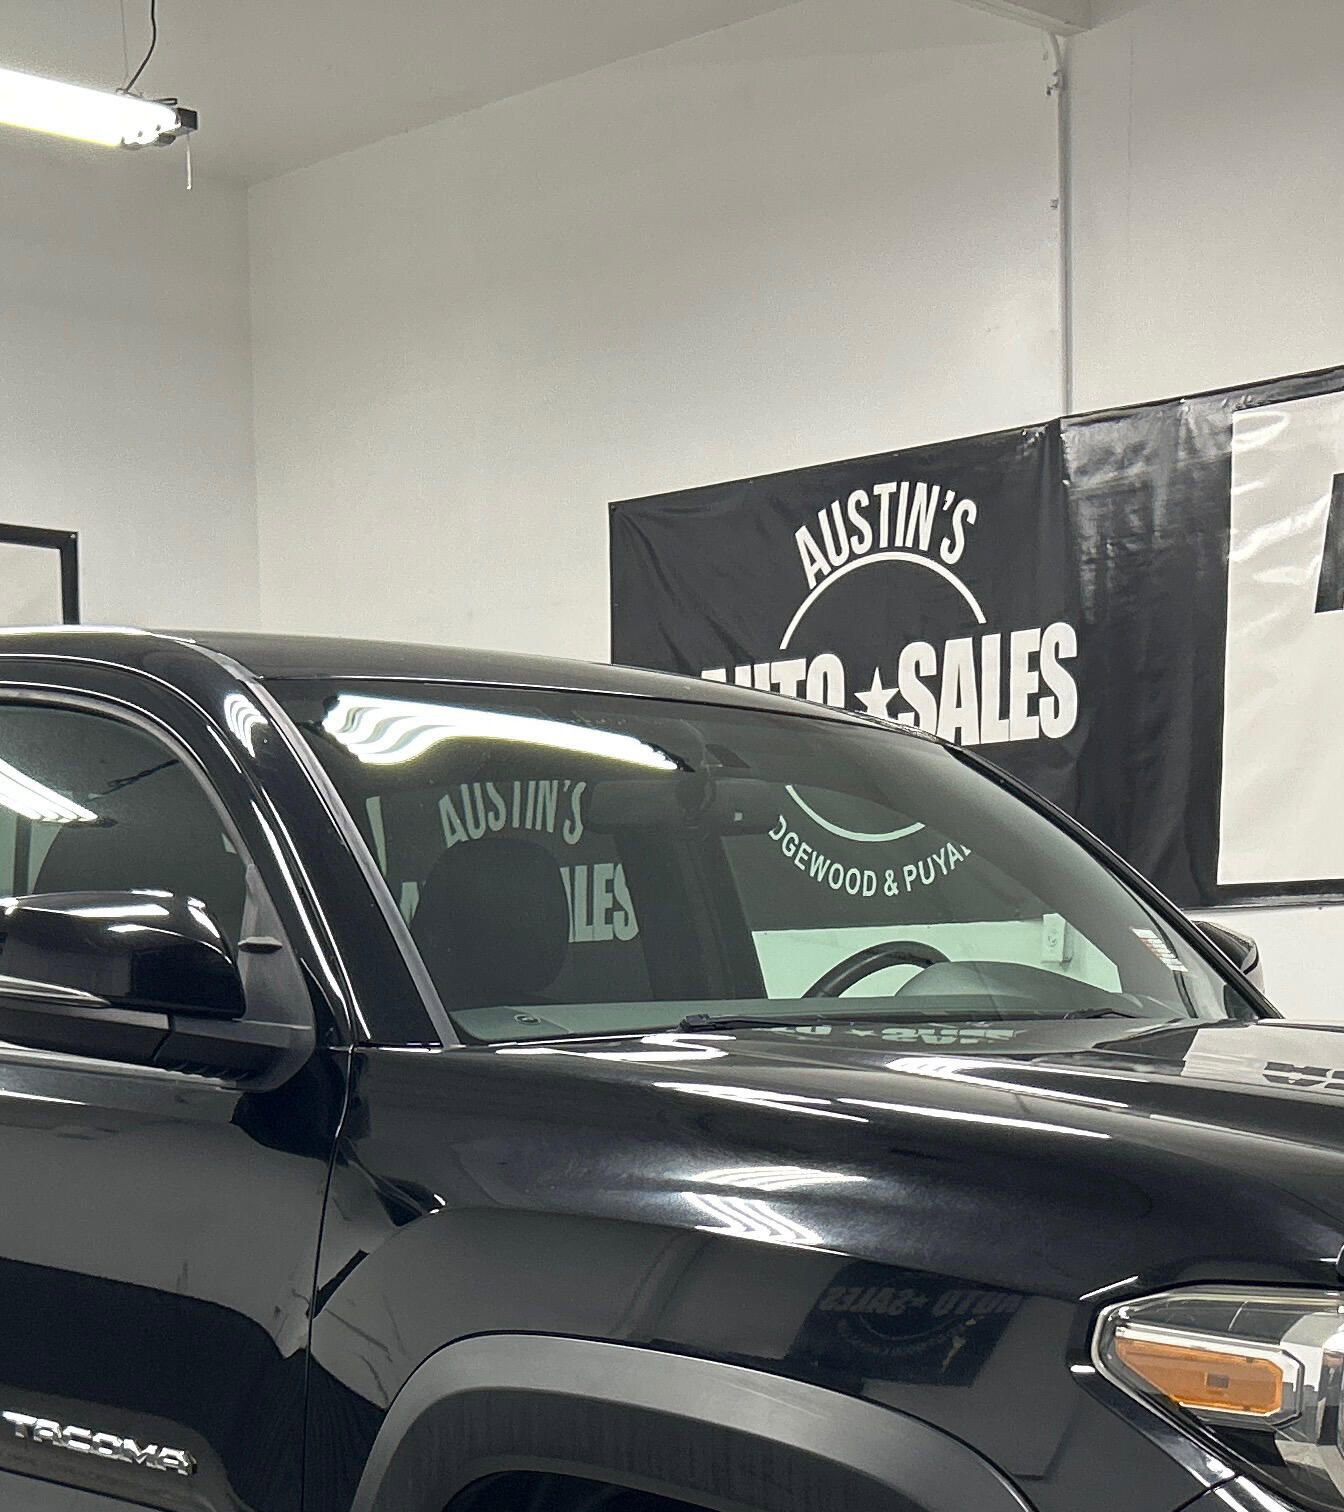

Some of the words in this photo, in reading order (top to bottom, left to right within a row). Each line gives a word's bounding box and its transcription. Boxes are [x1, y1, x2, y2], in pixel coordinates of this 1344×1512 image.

[794, 480, 978, 589] AUSTIN'S
[898, 622, 1078, 747] SALES
[560, 863, 640, 942] LES
[884, 869, 899, 896] &
[0, 1410, 198, 1476] TACOMA
